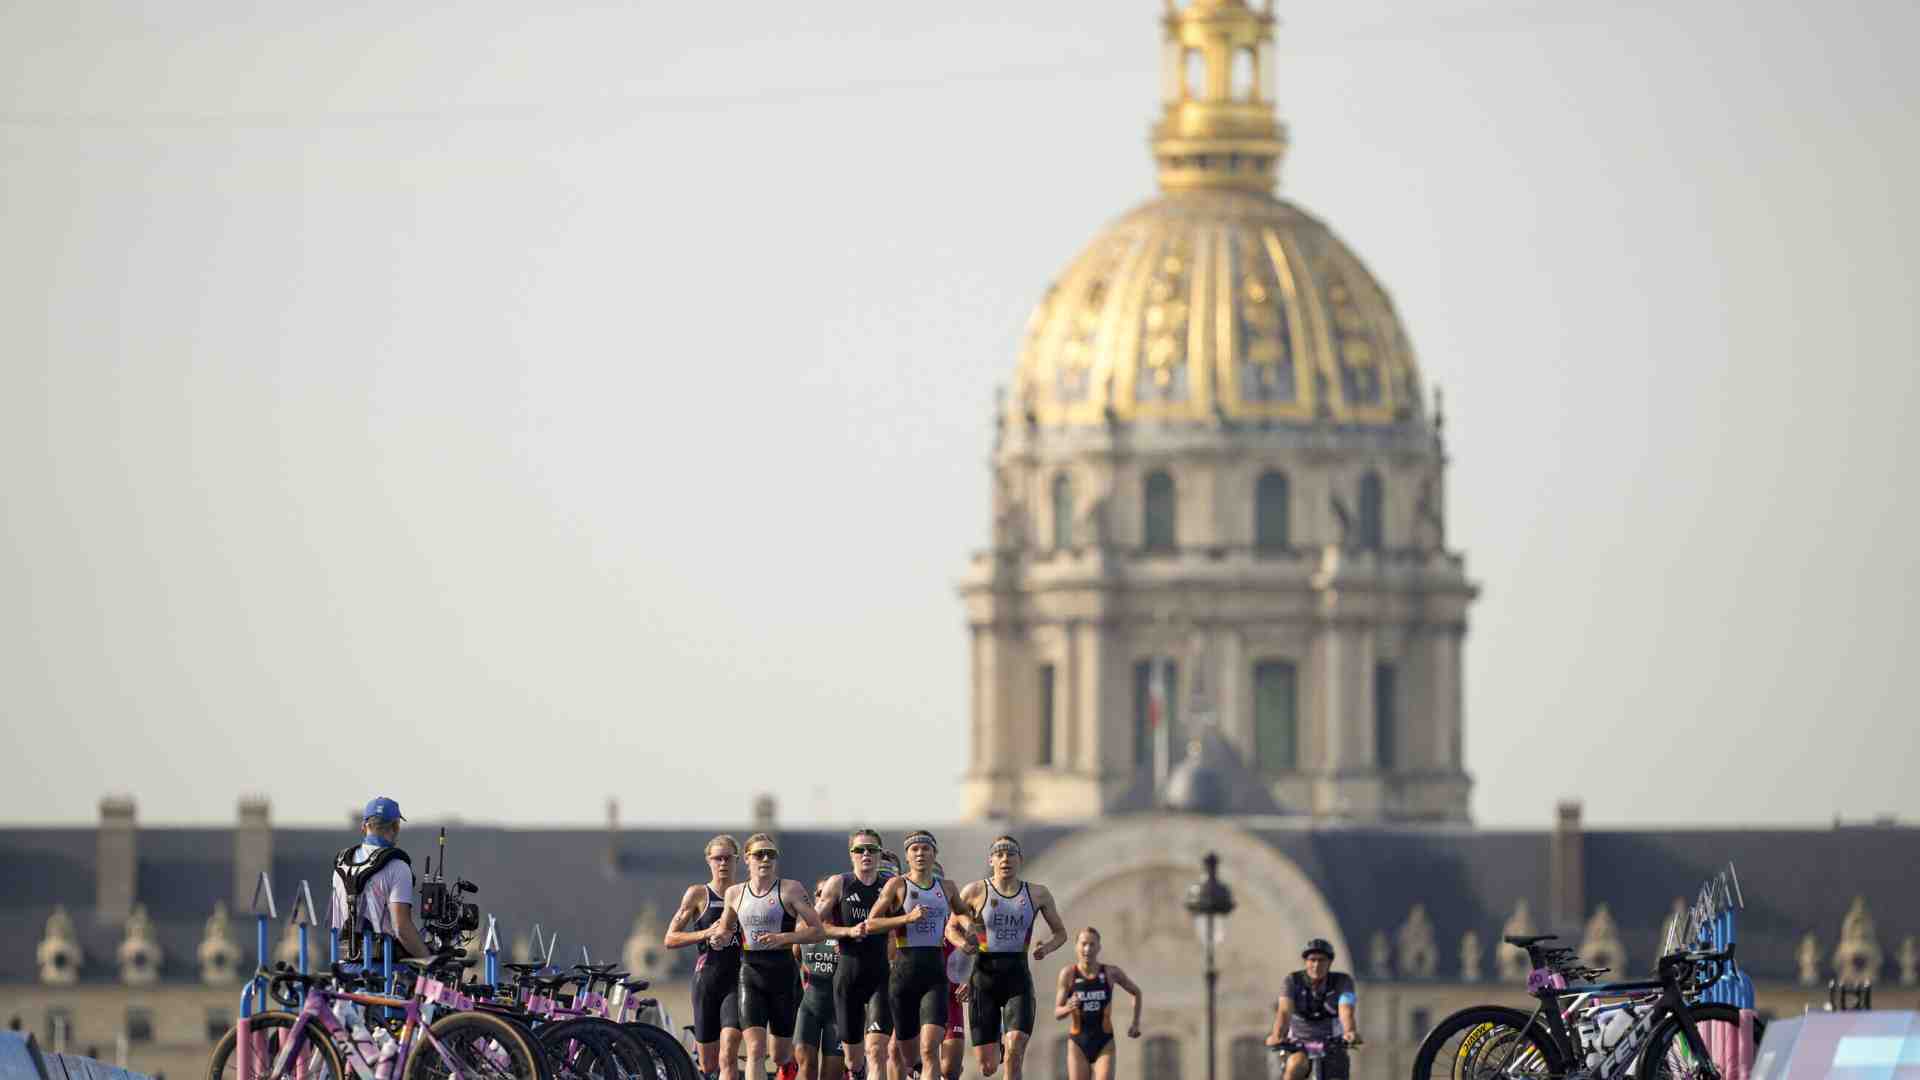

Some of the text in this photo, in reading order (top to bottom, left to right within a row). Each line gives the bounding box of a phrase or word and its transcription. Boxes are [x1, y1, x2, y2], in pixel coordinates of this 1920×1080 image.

[993, 913, 1024, 926] EIM
[916, 919, 936, 936] GER
[995, 929, 1017, 940] GER
[815, 961, 833, 973] POR
